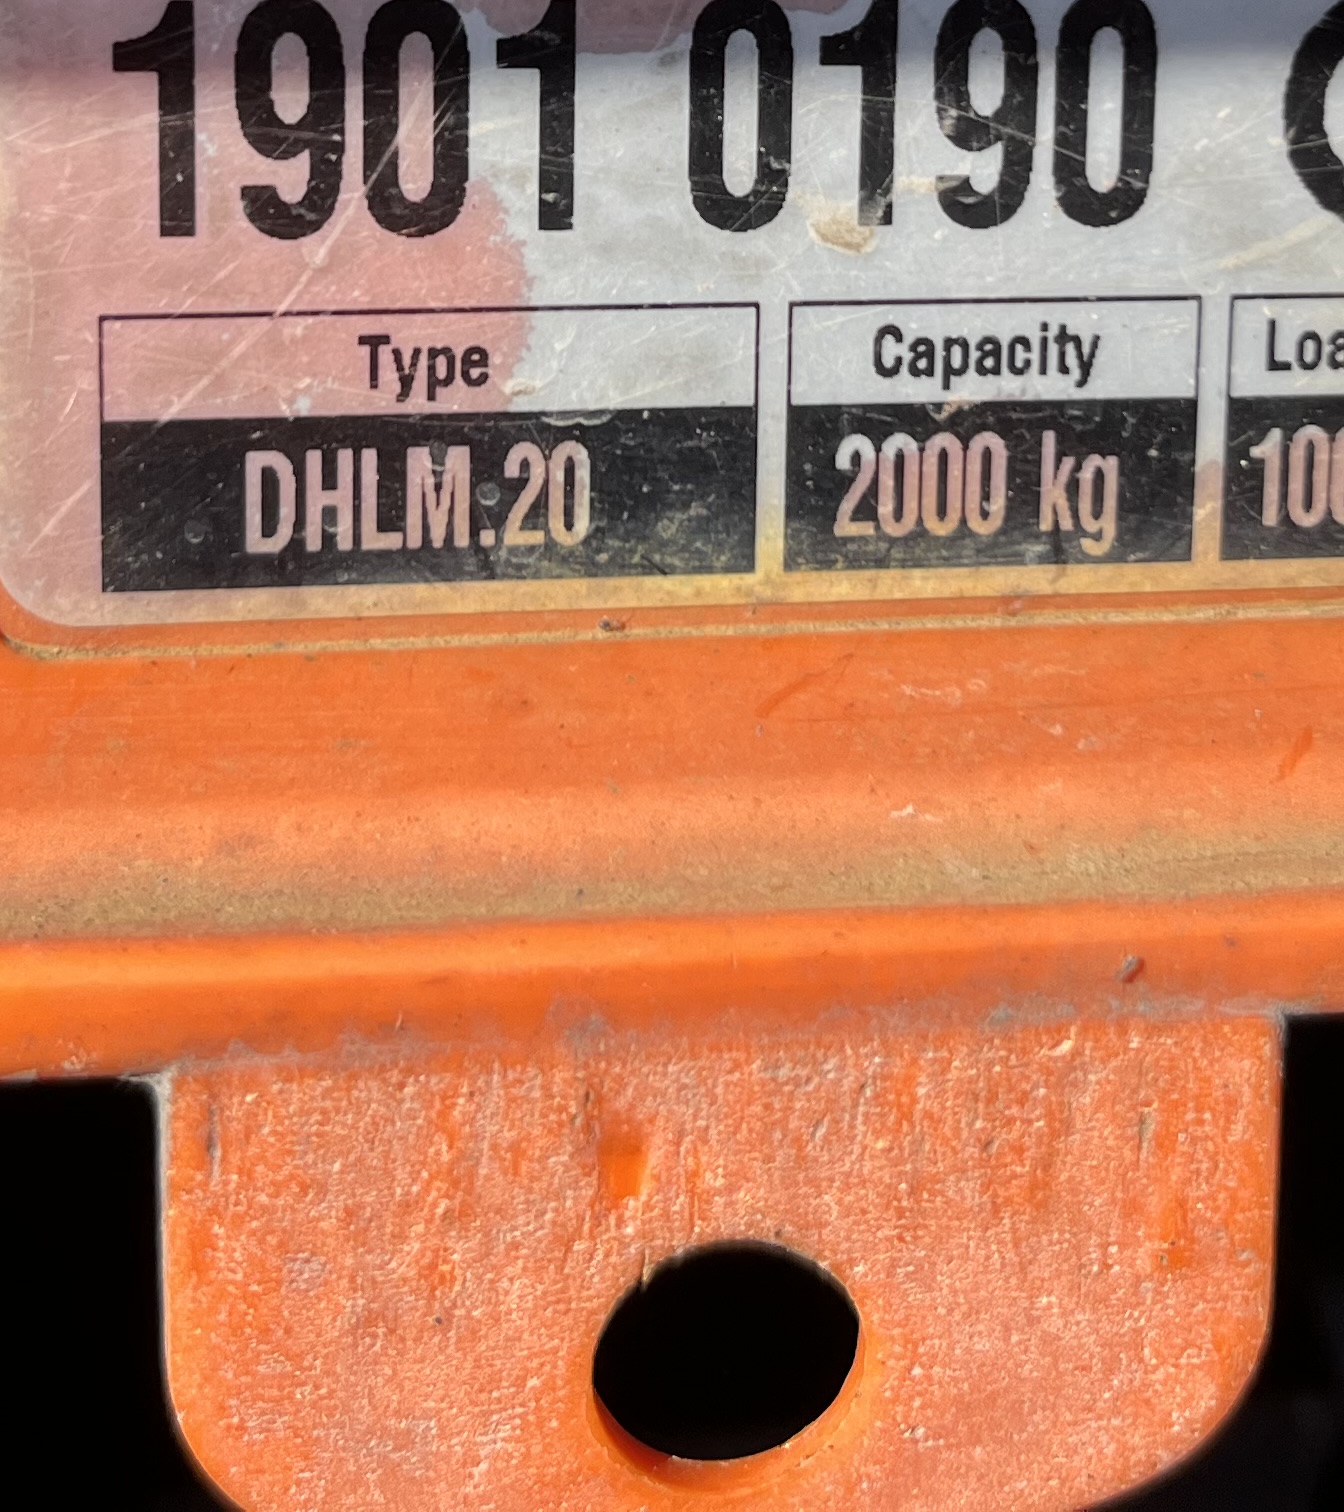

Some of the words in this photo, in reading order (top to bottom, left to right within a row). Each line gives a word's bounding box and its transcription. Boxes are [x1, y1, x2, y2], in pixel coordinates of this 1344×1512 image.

[357, 333, 491, 403] Type
[872, 321, 1102, 391] Capacity
[243, 439, 593, 556] DHLM.20
[832, 430, 1008, 540] 2000
[1038, 429, 1121, 557] kg
